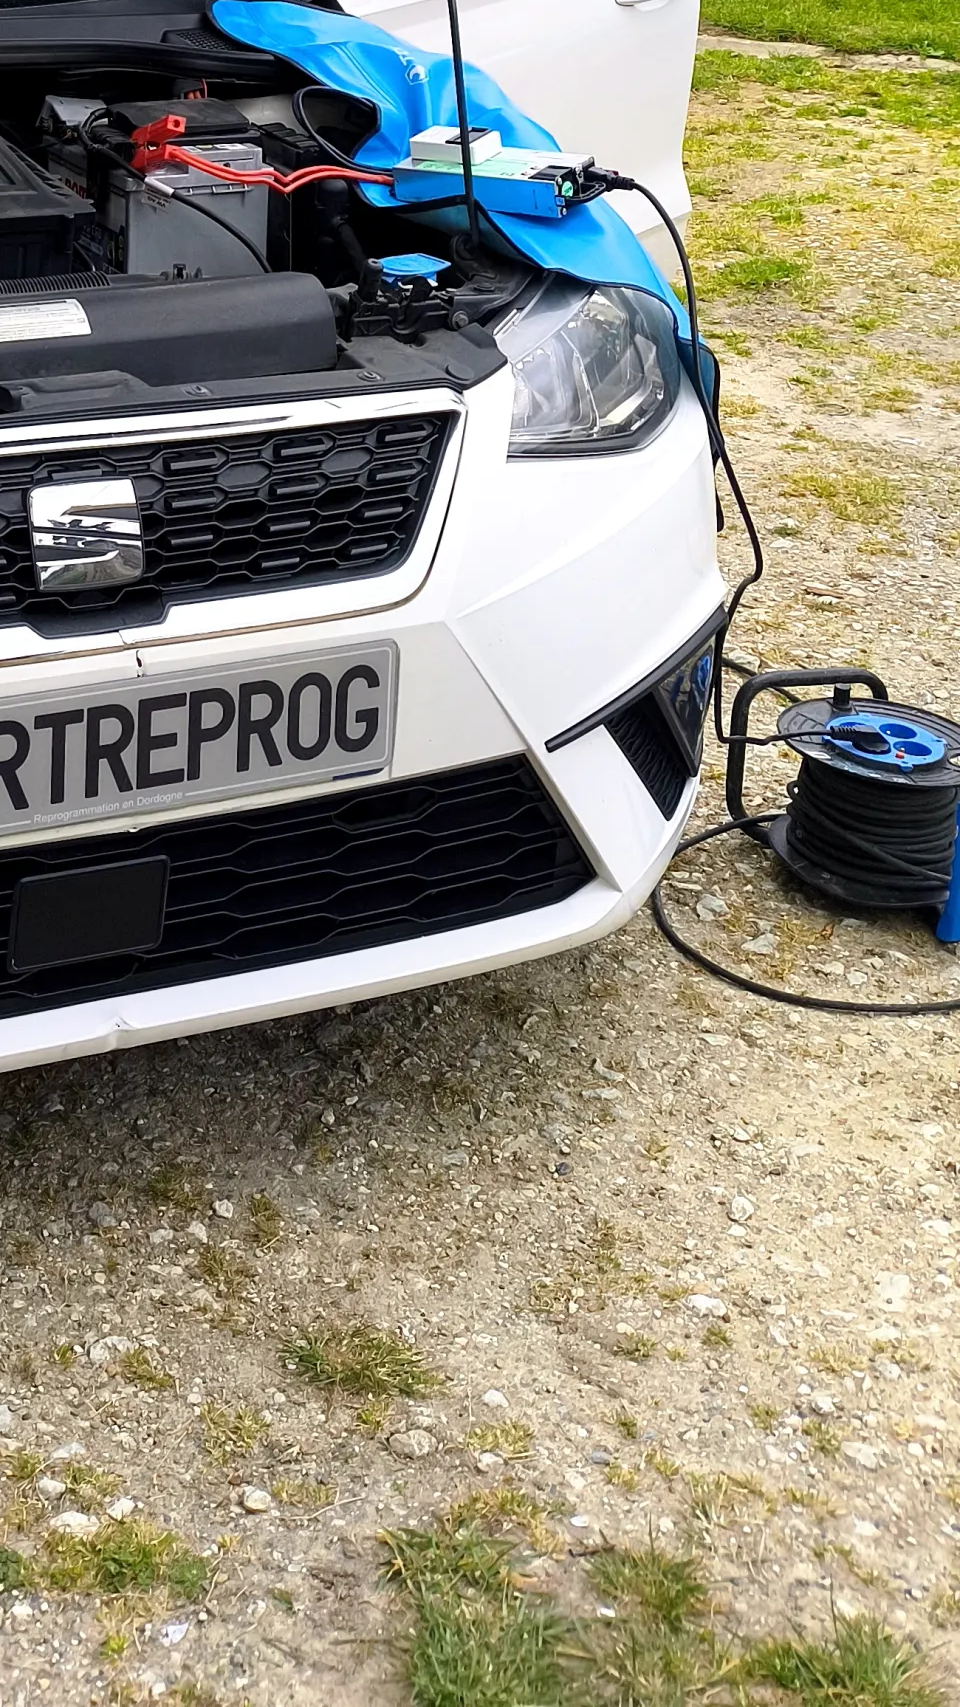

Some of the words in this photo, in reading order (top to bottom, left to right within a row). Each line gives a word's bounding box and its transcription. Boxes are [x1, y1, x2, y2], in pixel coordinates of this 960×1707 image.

[33, 802, 120, 824] Reprogrammation
[122, 799, 134, 809] en
[136, 791, 183, 807] Dordogne
